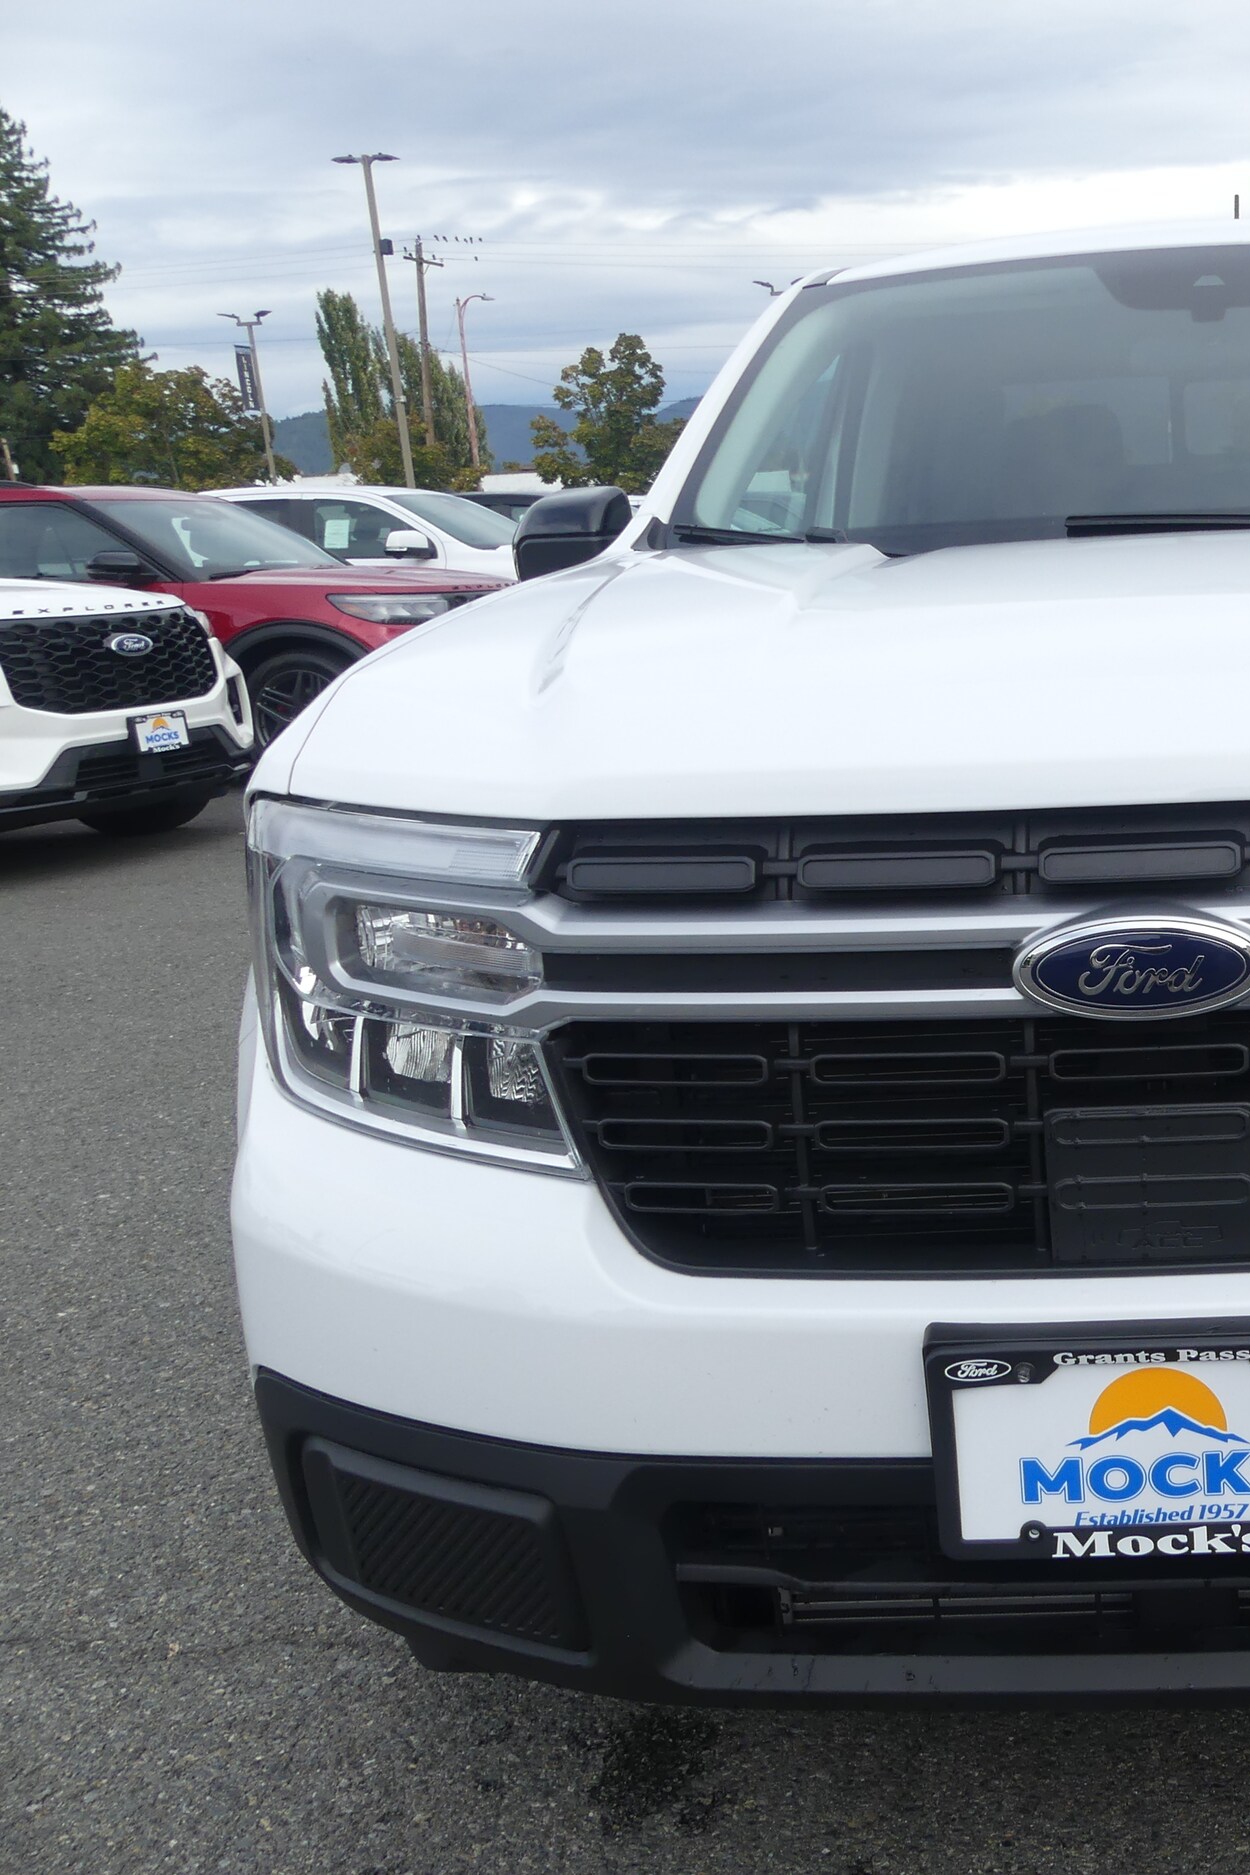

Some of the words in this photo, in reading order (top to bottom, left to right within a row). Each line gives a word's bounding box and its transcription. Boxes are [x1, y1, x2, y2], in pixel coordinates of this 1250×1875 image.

[12, 600, 165, 616] EXPLORER
[123, 638, 145, 651] Ford
[145, 731, 179, 743] MOCKS
[1078, 944, 1205, 996] Ford
[1053, 1350, 1166, 1365] Grants
[1176, 1349, 1250, 1362] Pass
[957, 1362, 998, 1378] Ford
[1075, 1505, 1194, 1527] Established
[1198, 1503, 1249, 1520] 1957
